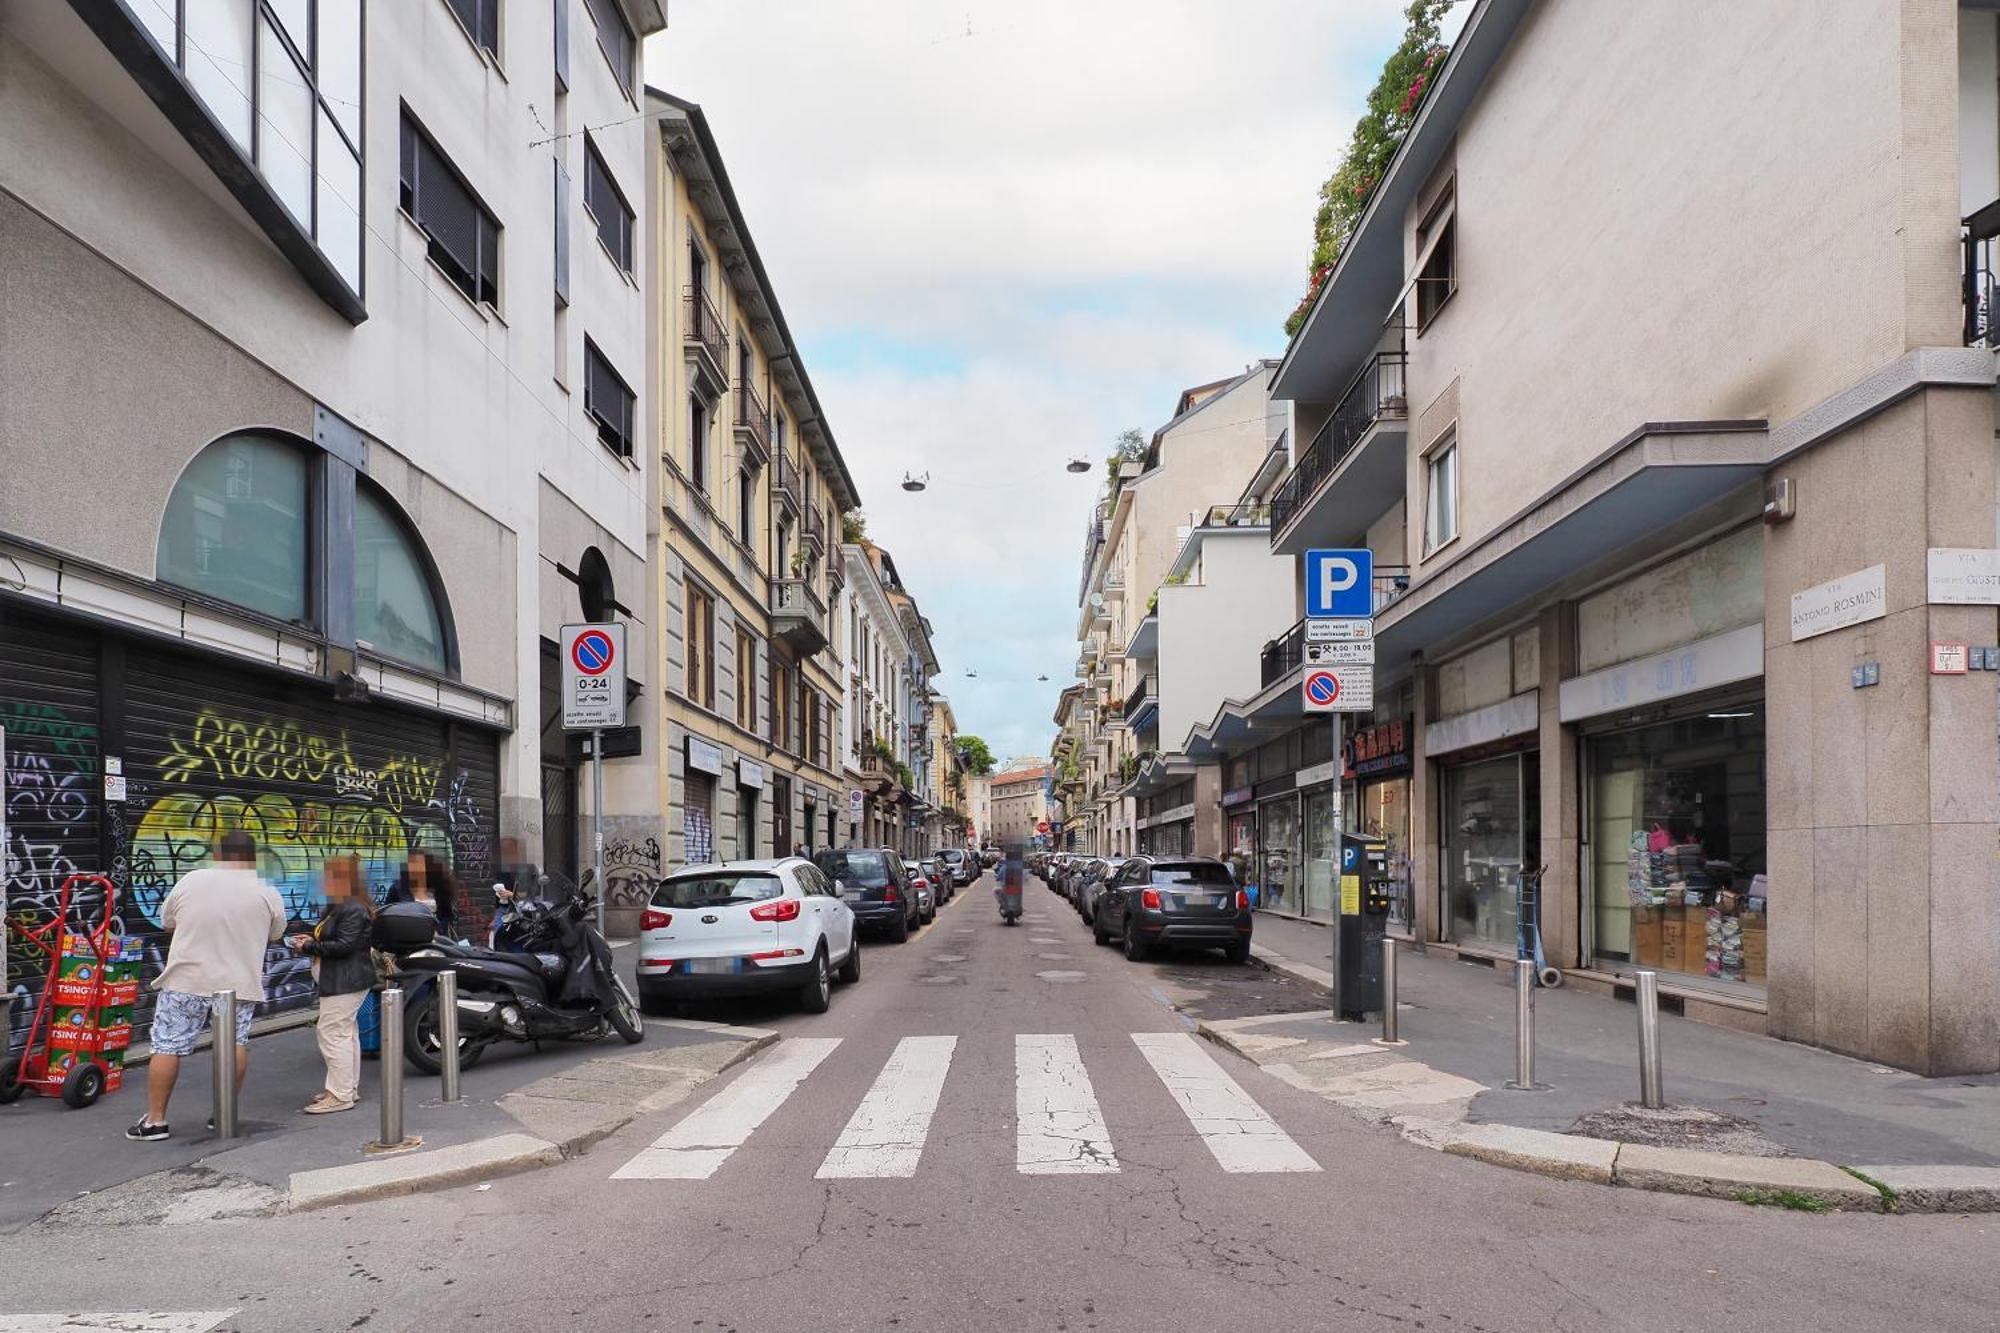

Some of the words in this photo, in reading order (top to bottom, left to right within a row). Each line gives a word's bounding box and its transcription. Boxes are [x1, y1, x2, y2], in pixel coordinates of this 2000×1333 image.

[1321, 557, 1358, 609] P
[1793, 605, 1830, 626] ANTONIO
[1834, 586, 1881, 613] ROSMINI
[579, 679, 607, 689] 0-24
[1344, 848, 1354, 867] P
